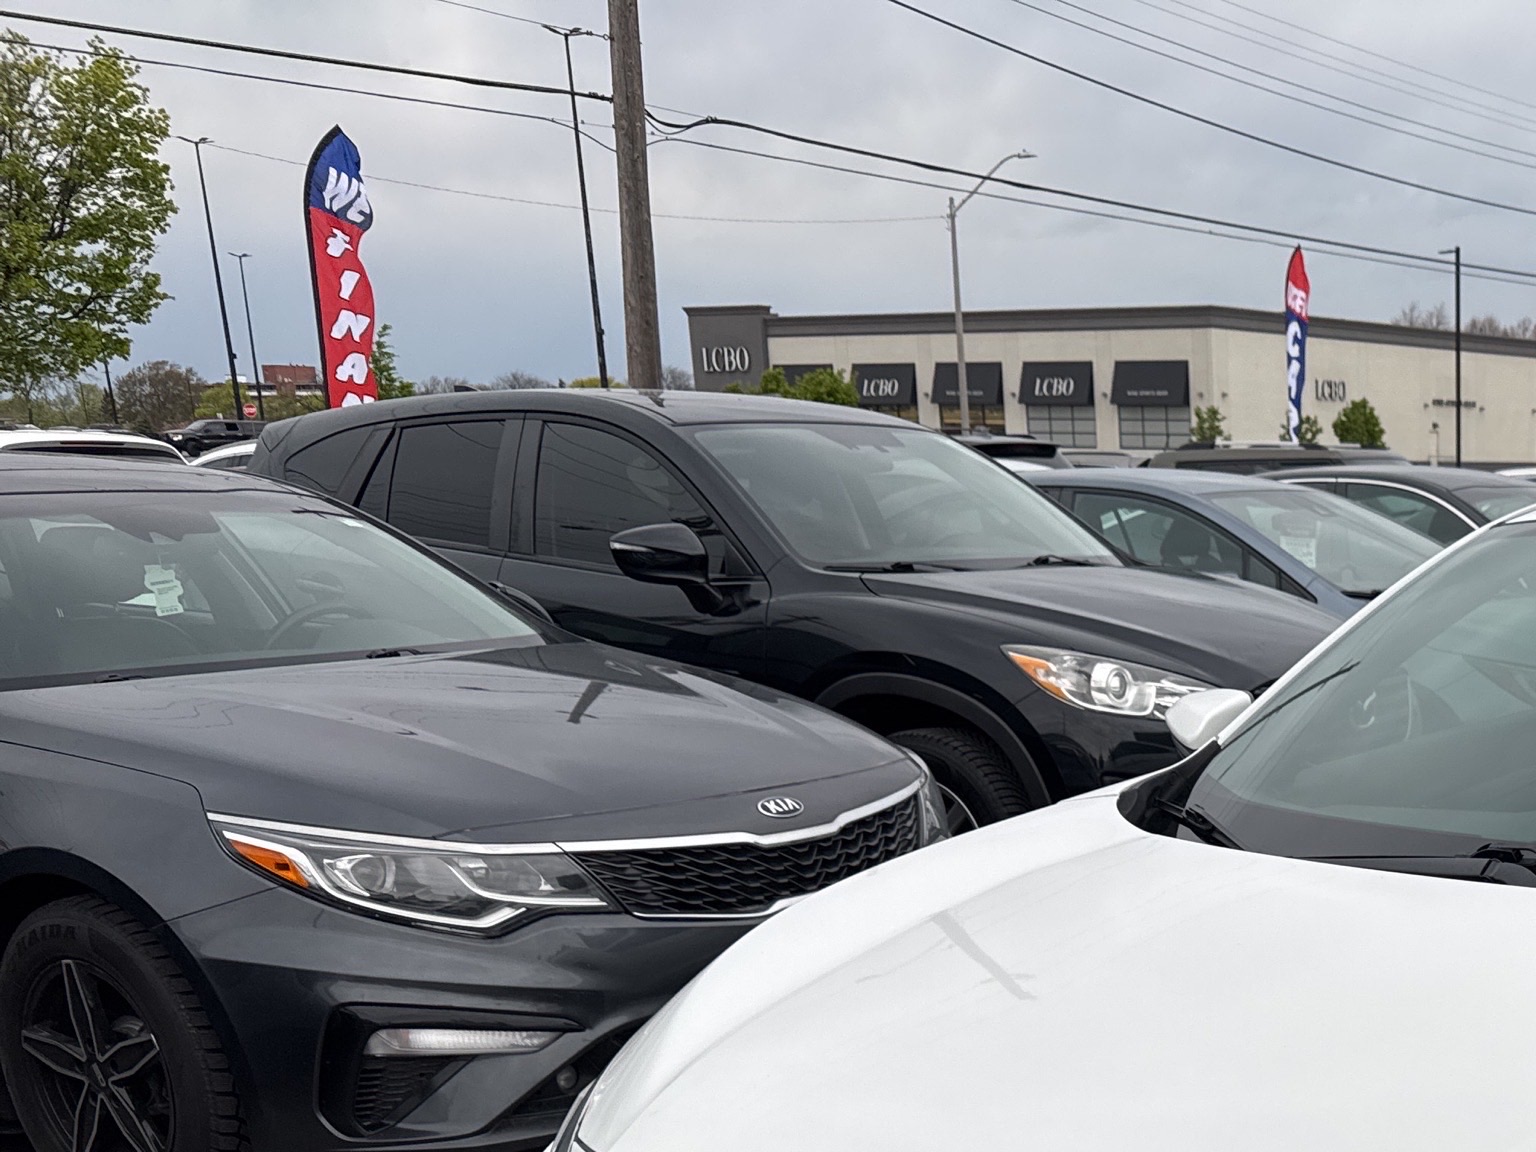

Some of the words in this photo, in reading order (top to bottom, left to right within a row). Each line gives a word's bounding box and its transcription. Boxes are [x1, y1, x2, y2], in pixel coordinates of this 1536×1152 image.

[702, 346, 750, 373] LCBO
[862, 378, 899, 397] LCBO
[1035, 377, 1075, 397] LCBO
[1315, 378, 1346, 401] LCBO
[763, 798, 801, 814] KIA
